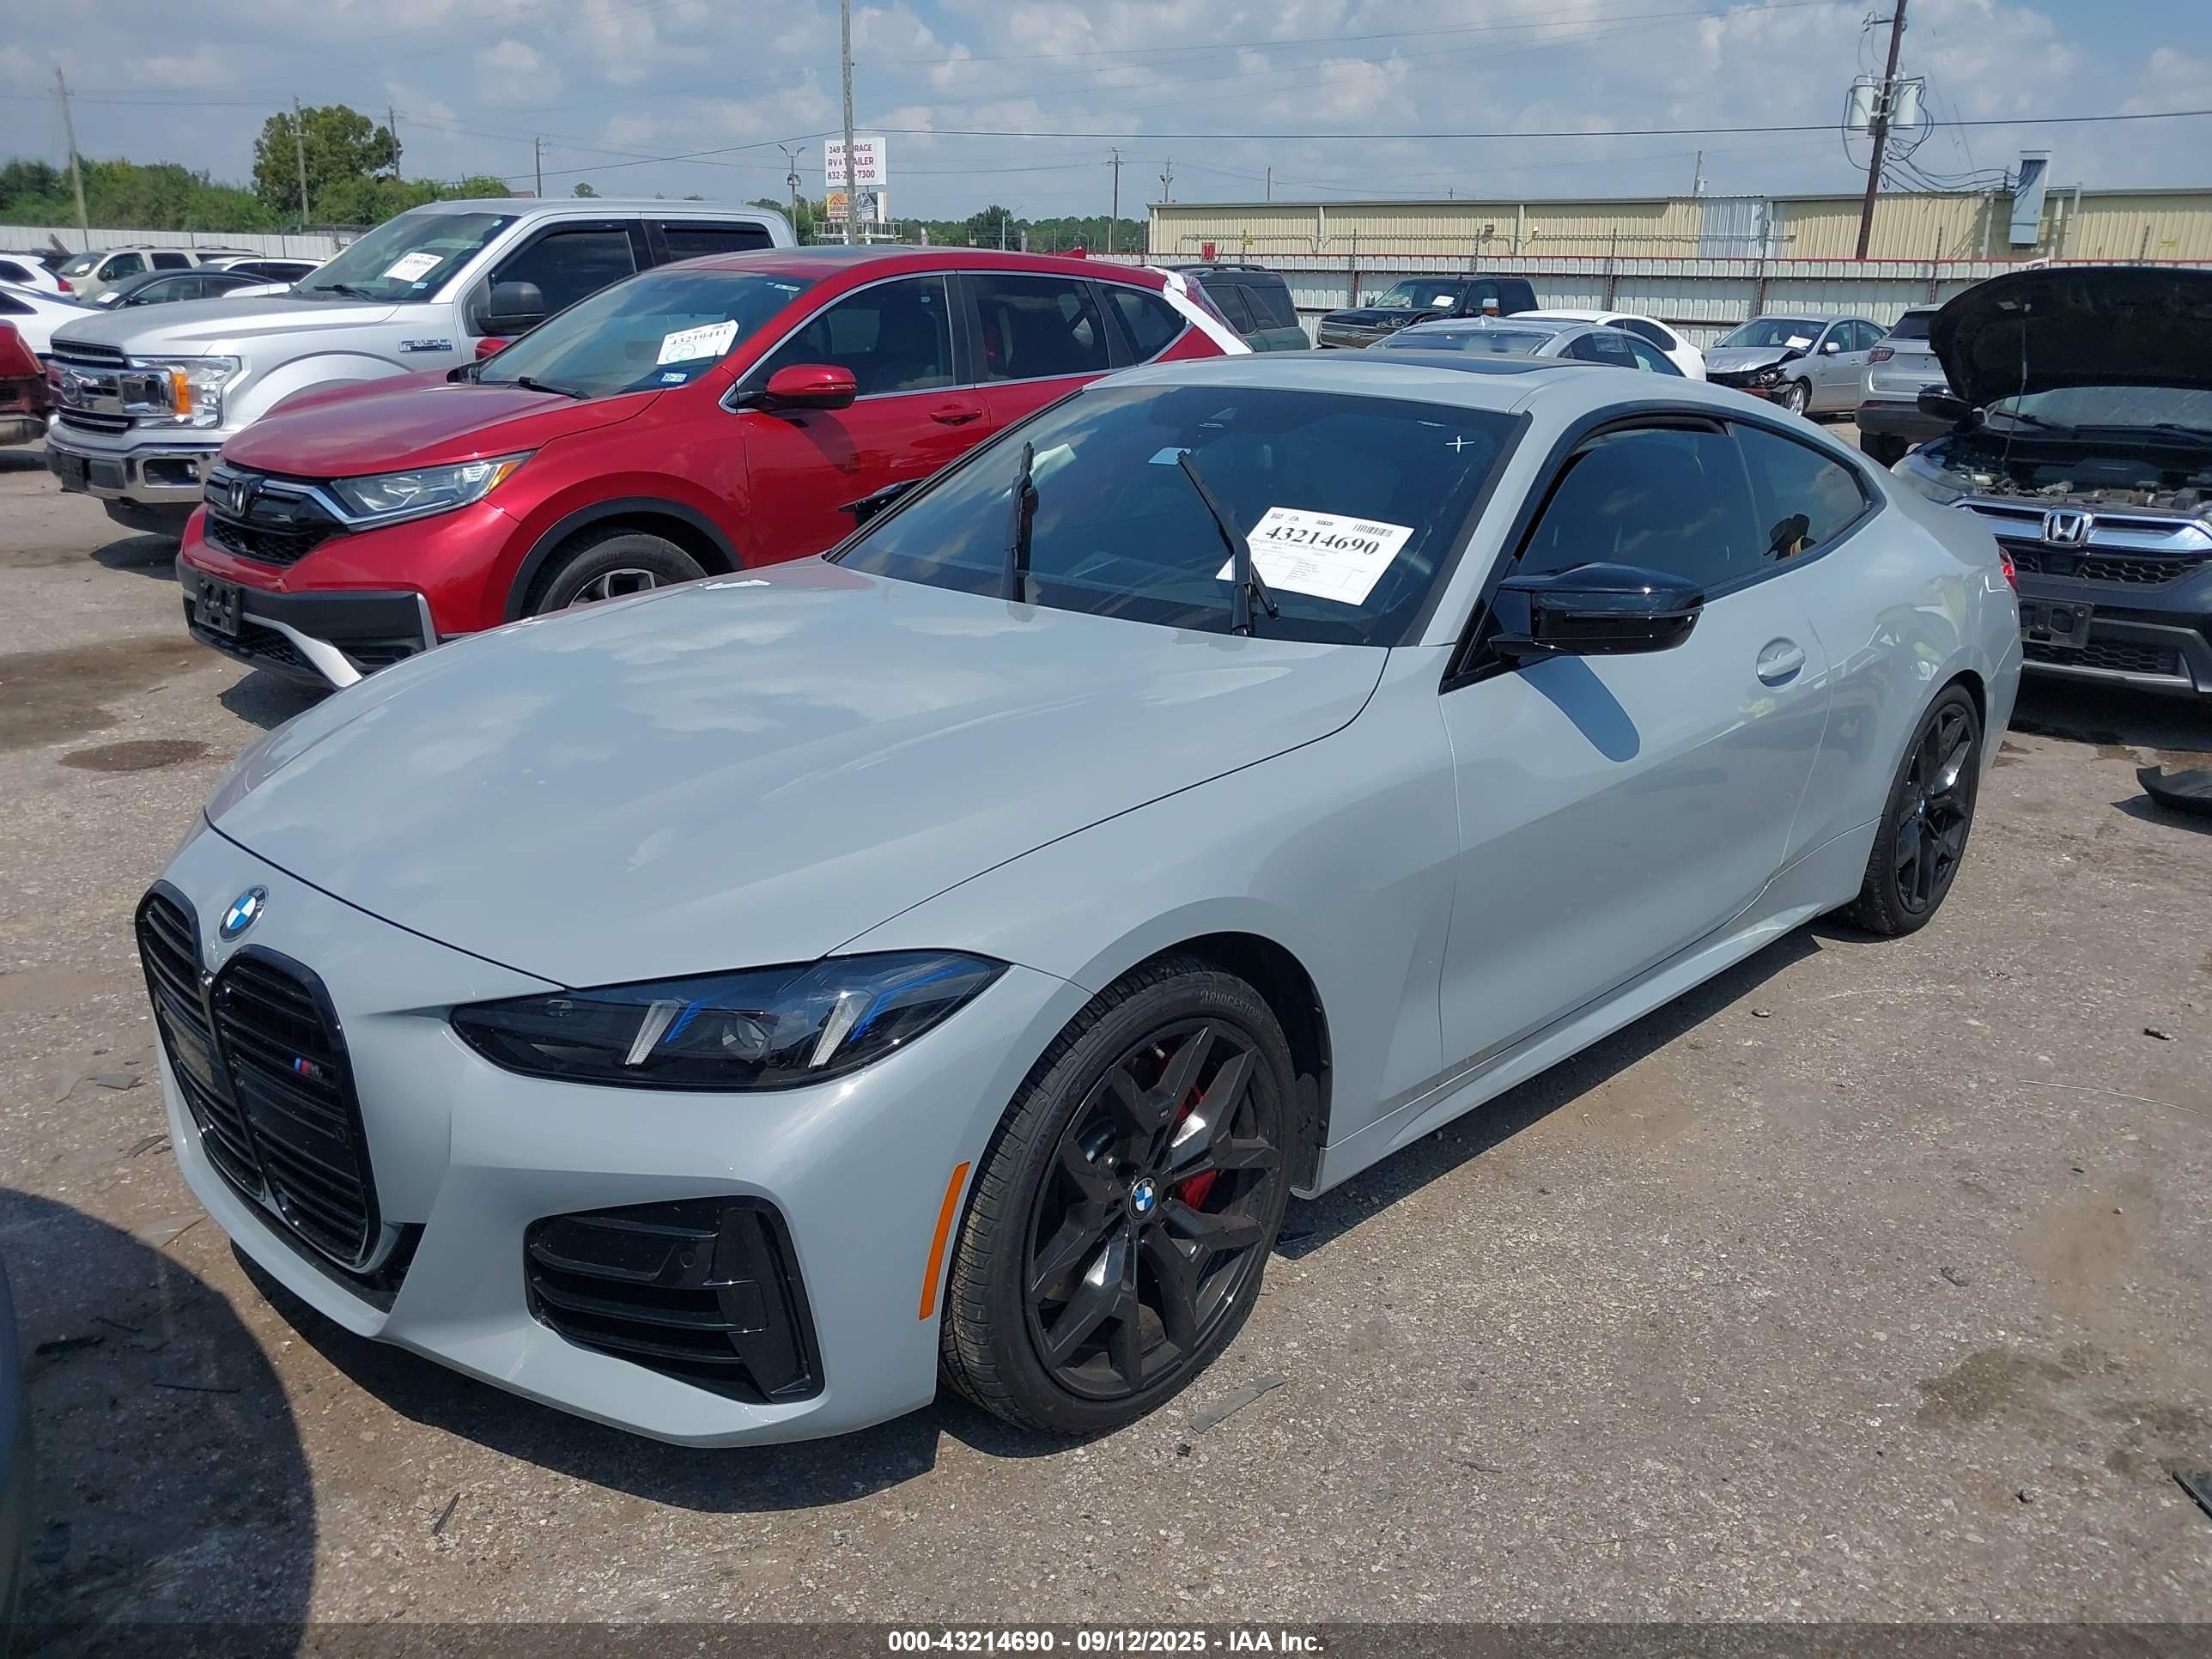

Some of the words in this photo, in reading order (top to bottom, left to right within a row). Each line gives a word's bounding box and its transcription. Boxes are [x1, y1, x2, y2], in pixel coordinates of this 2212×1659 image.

[842, 144, 872, 153] SRAGE
[829, 158, 838, 167] RV
[827, 170, 875, 179] 832-2-7300
[1266, 526, 1380, 556] 43214690
